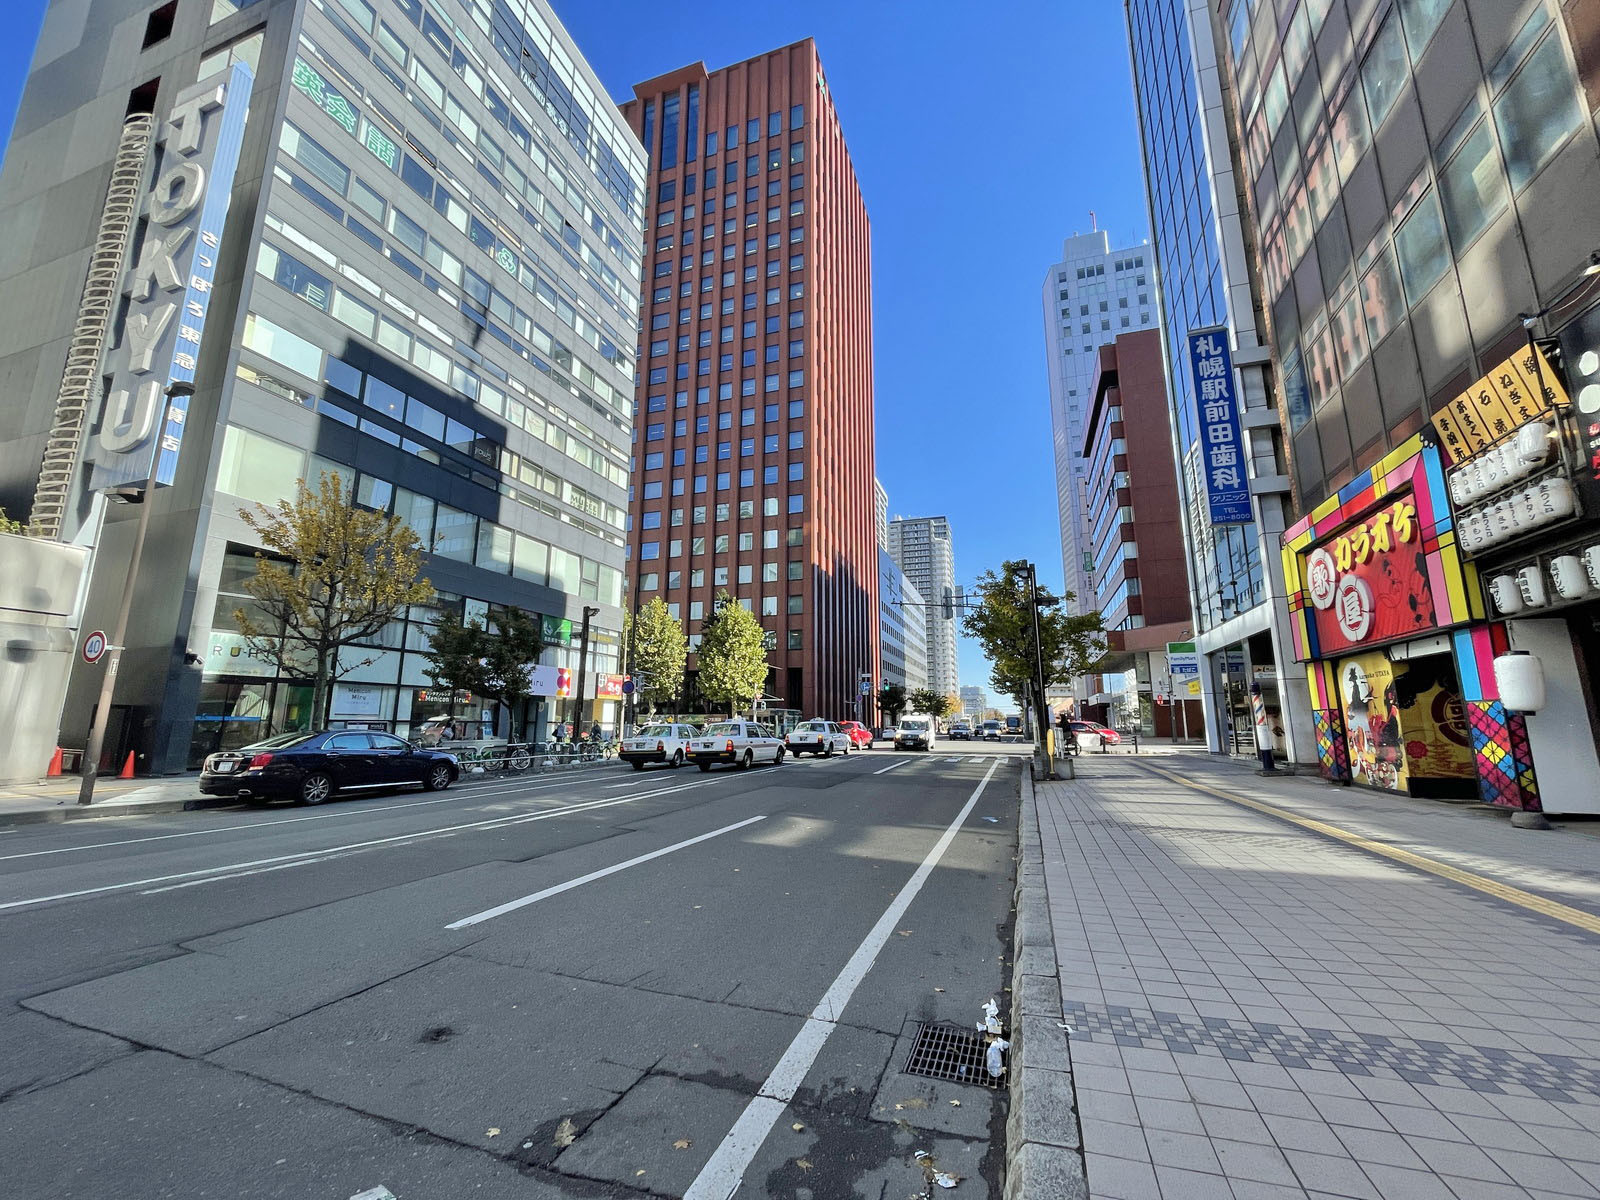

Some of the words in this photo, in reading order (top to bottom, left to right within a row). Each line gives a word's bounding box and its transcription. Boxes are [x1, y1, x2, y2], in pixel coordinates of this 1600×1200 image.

[520, 67, 546, 107] YAKINIKU
[292, 58, 396, 169] 英会話
[101, 83, 226, 450] TOKYU
[161, 230, 219, 451] さっぽろ東急貨店
[1196, 335, 1240, 490] 札幌駅前田歯科
[1499, 373, 1532, 421] ねぎま
[1438, 418, 1466, 461] 手羽先
[1211, 493, 1247, 503] クリニック
[1213, 513, 1251, 522] 251-8000
[1223, 506, 1239, 514] TEL
[1334, 501, 1416, 573] カラオケ
[87, 640, 101, 654] 40
[426, 695, 450, 703] Menicon
